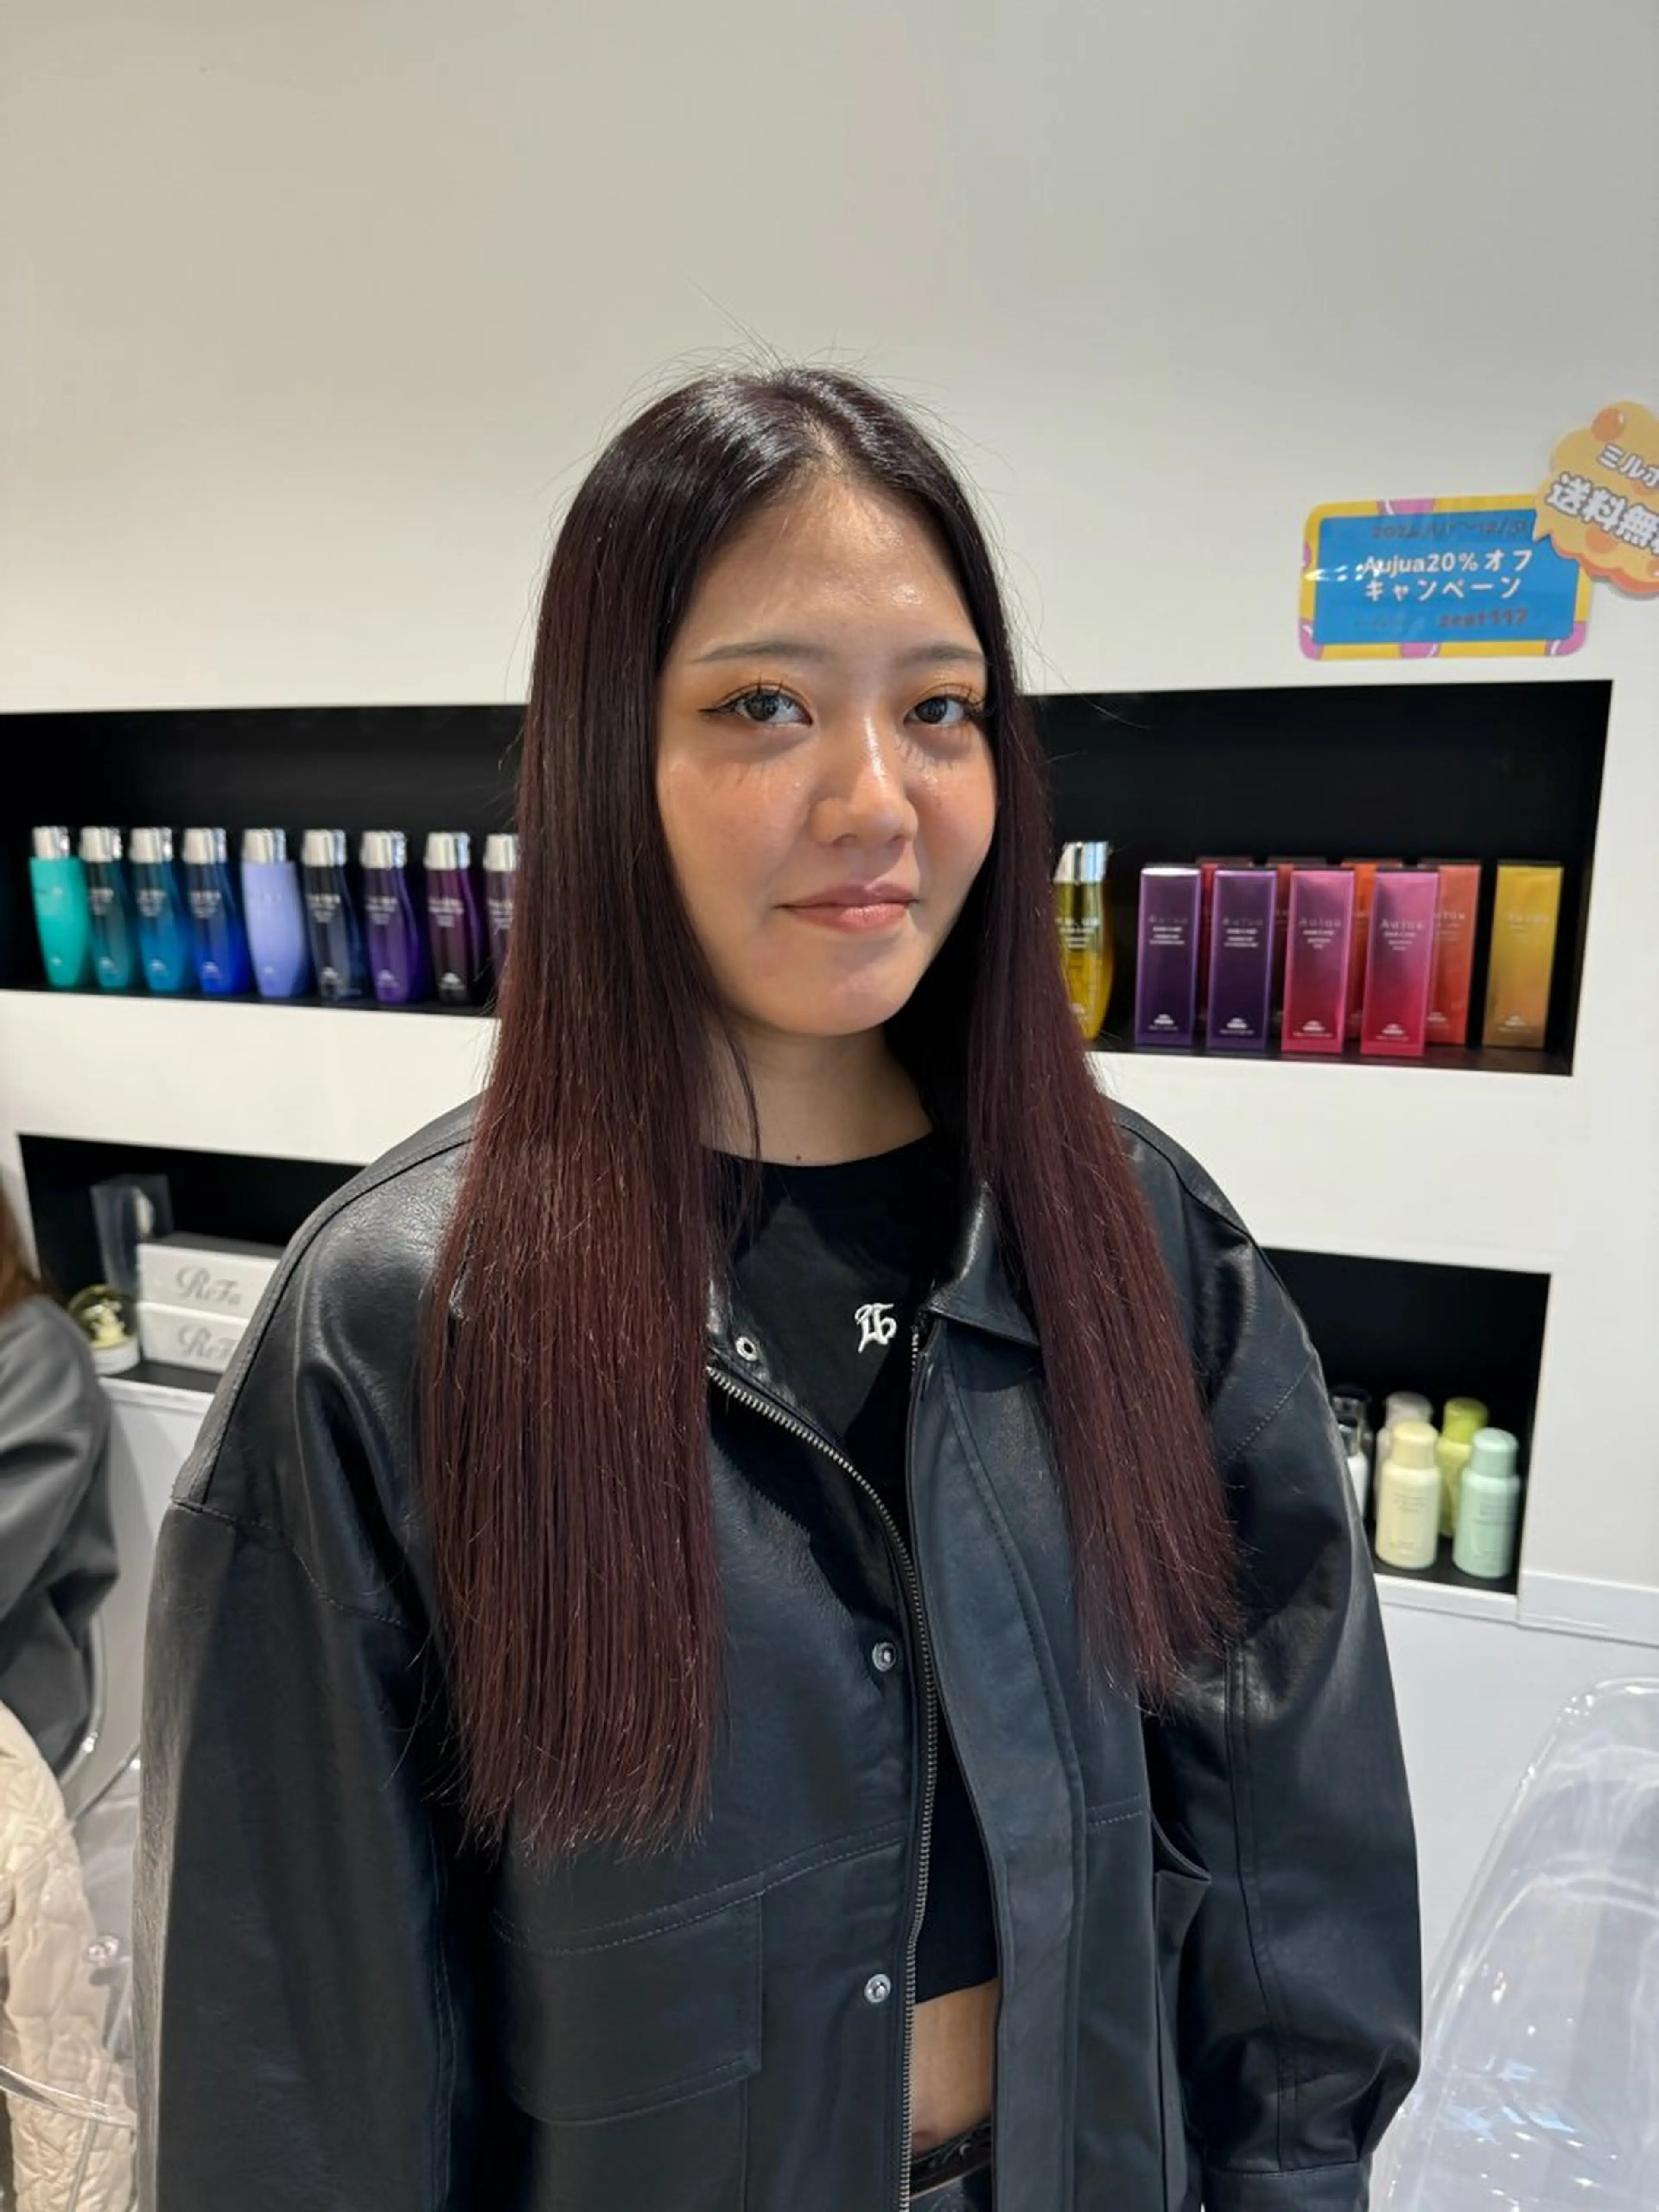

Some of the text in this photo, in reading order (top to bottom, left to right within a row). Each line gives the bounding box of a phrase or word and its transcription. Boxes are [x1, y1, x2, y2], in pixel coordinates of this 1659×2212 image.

[1364, 576, 1522, 601] キャンペーン
